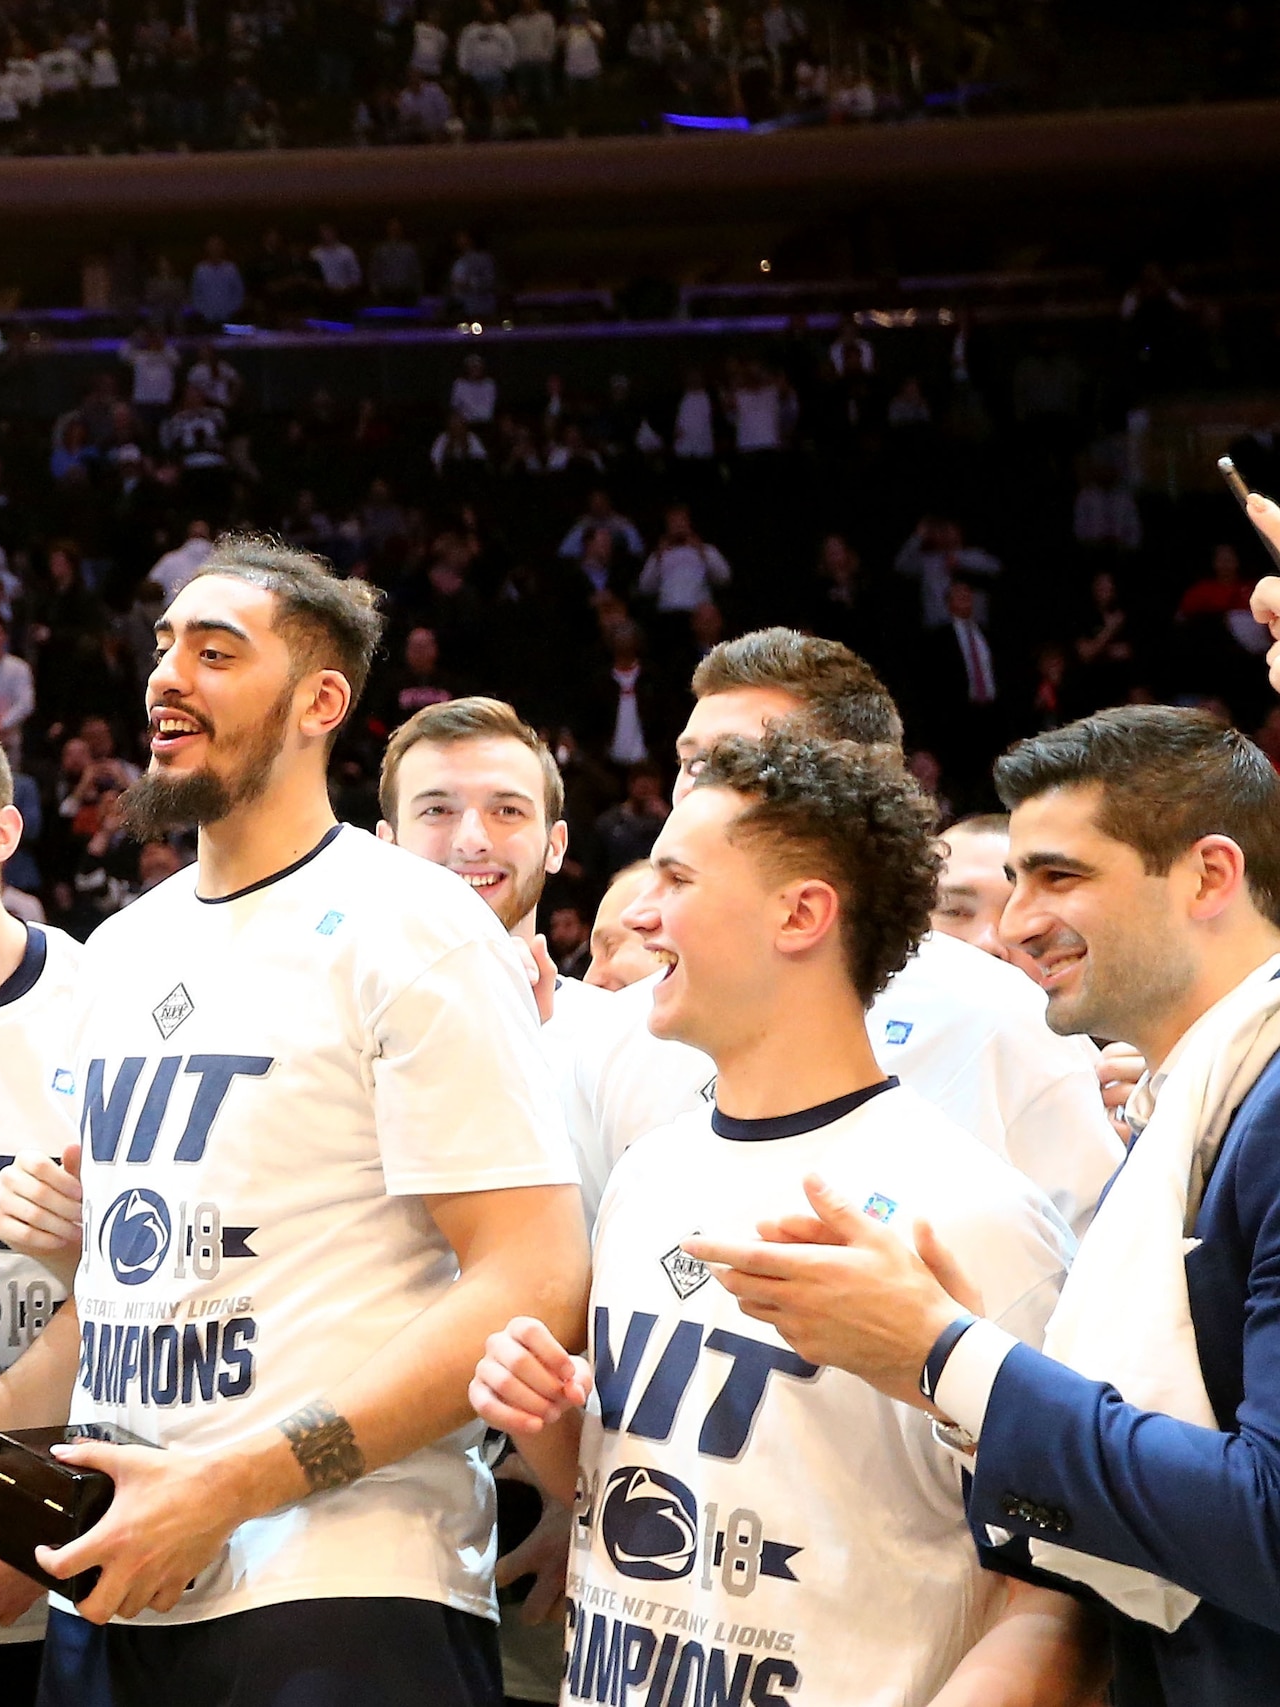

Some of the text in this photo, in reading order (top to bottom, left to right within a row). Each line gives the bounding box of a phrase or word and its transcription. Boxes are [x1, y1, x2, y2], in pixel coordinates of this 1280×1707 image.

[80, 1054, 275, 1166] NIT
[174, 1200, 221, 1281] 18
[7, 1279, 53, 1347] 18
[594, 1306, 822, 1464] NIT
[701, 1502, 764, 1599] 18
[622, 1595, 709, 1637] NITTANY
[714, 1621, 797, 1655] LIONS.
